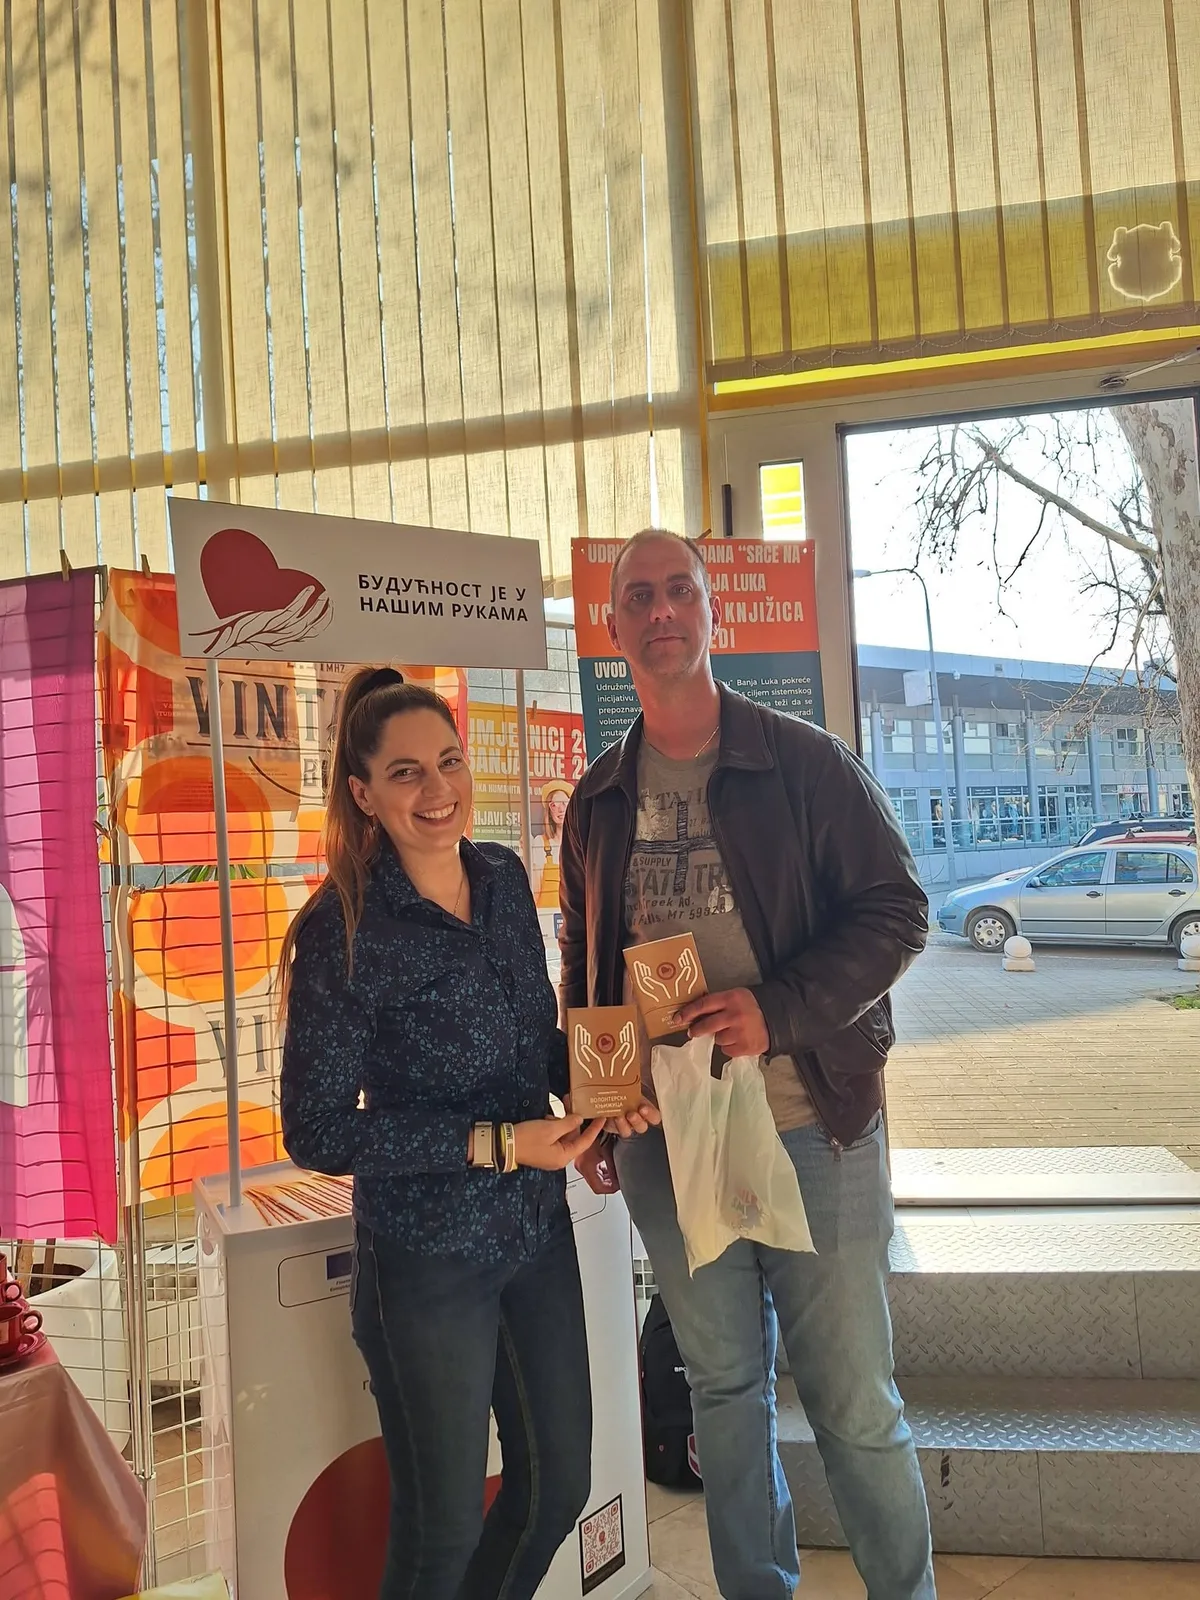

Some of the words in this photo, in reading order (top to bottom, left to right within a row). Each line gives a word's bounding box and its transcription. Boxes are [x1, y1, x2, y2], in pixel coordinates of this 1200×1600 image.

[783, 544, 801, 563] NA
[358, 574, 482, 599] БУДУЋНОСТ
[490, 585, 507, 603] ЈЕ
[515, 588, 527, 602] У
[733, 573, 766, 592] LUKA
[360, 596, 444, 618] НАШИМ
[452, 603, 528, 622] РУКАМА
[725, 596, 804, 623] KNJIŽICA
[594, 661, 627, 678] UVOD
[596, 683, 635, 691] Udruženje
[737, 679, 757, 688] Banja
[782, 676, 811, 686] pokreće
[597, 694, 634, 703] inicijativu
[748, 689, 770, 697] ciljem
[771, 687, 812, 696] sistemskog
[775, 698, 788, 707] teži
[186, 676, 341, 743] VINT
[506, 811, 521, 828] SE!
